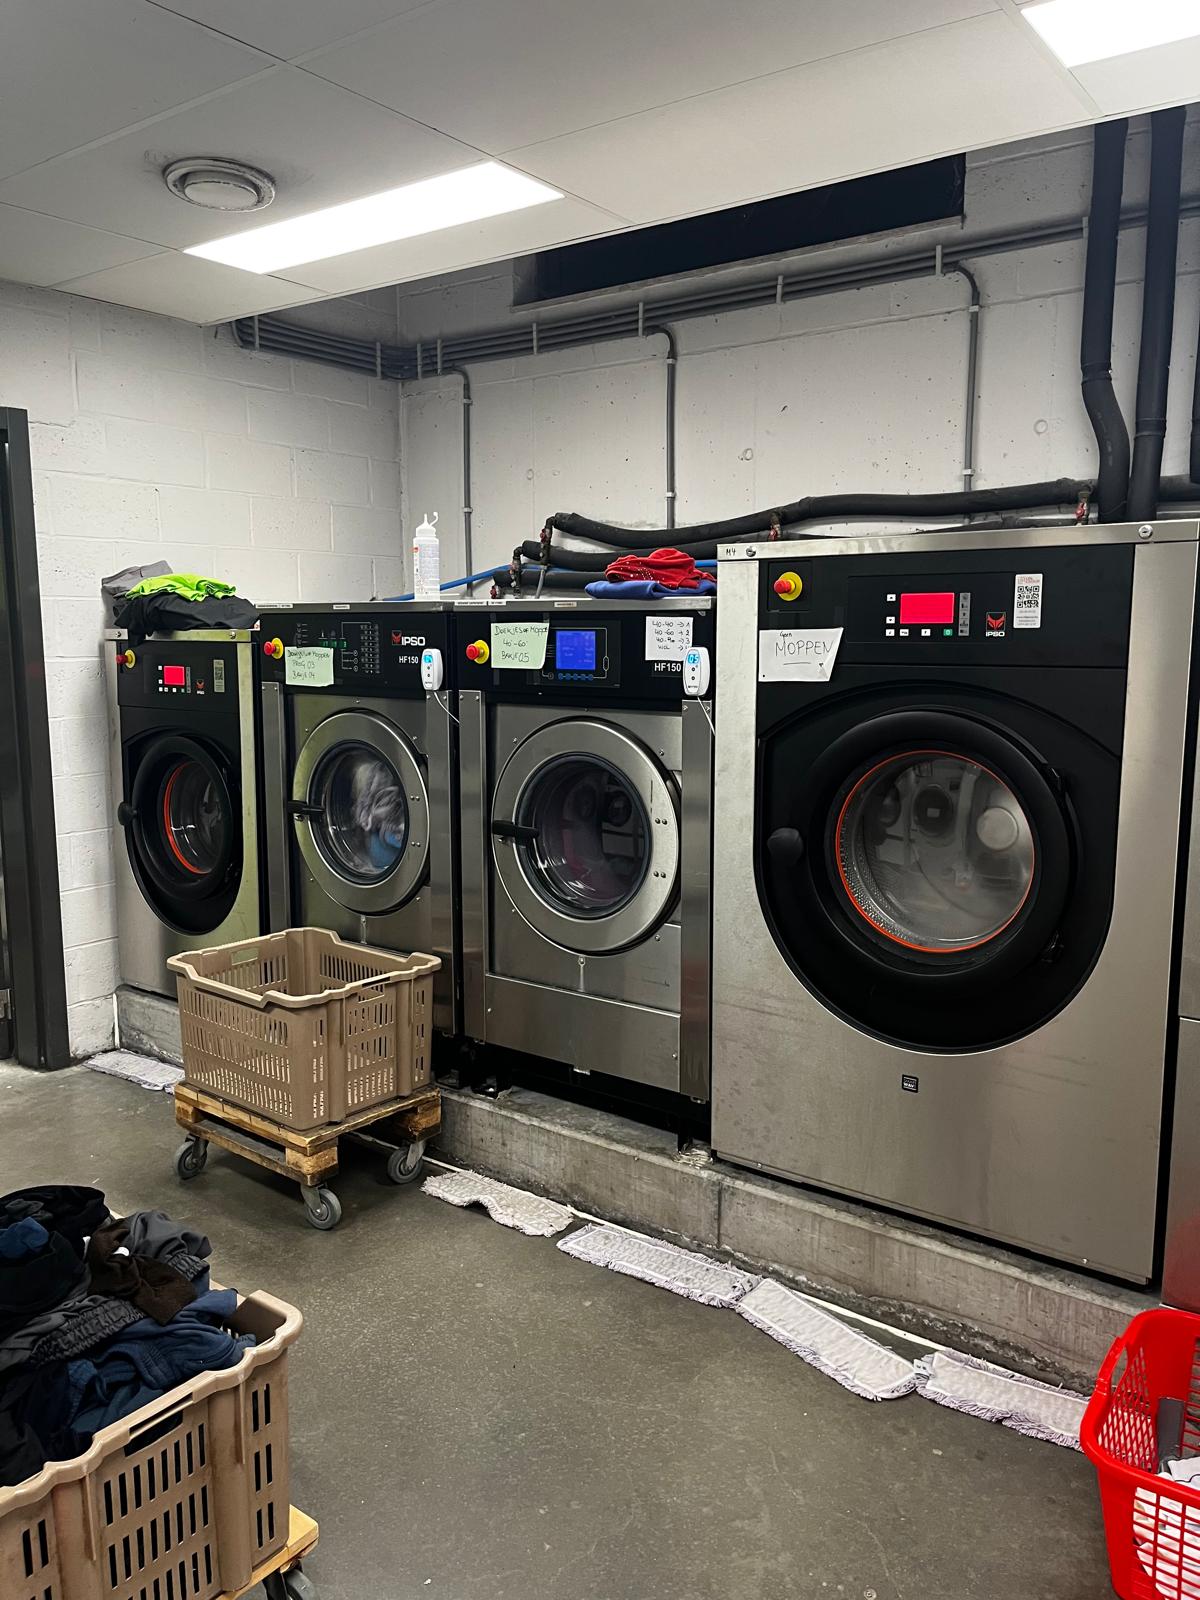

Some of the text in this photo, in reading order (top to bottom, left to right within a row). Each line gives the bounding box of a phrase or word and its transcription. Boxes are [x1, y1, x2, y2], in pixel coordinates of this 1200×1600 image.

[401, 636, 426, 646] IPSO
[775, 638, 834, 657] MOPPEN
[399, 655, 419, 664] HF150
[689, 654, 699, 664] 05
[654, 662, 682, 672] HF150
